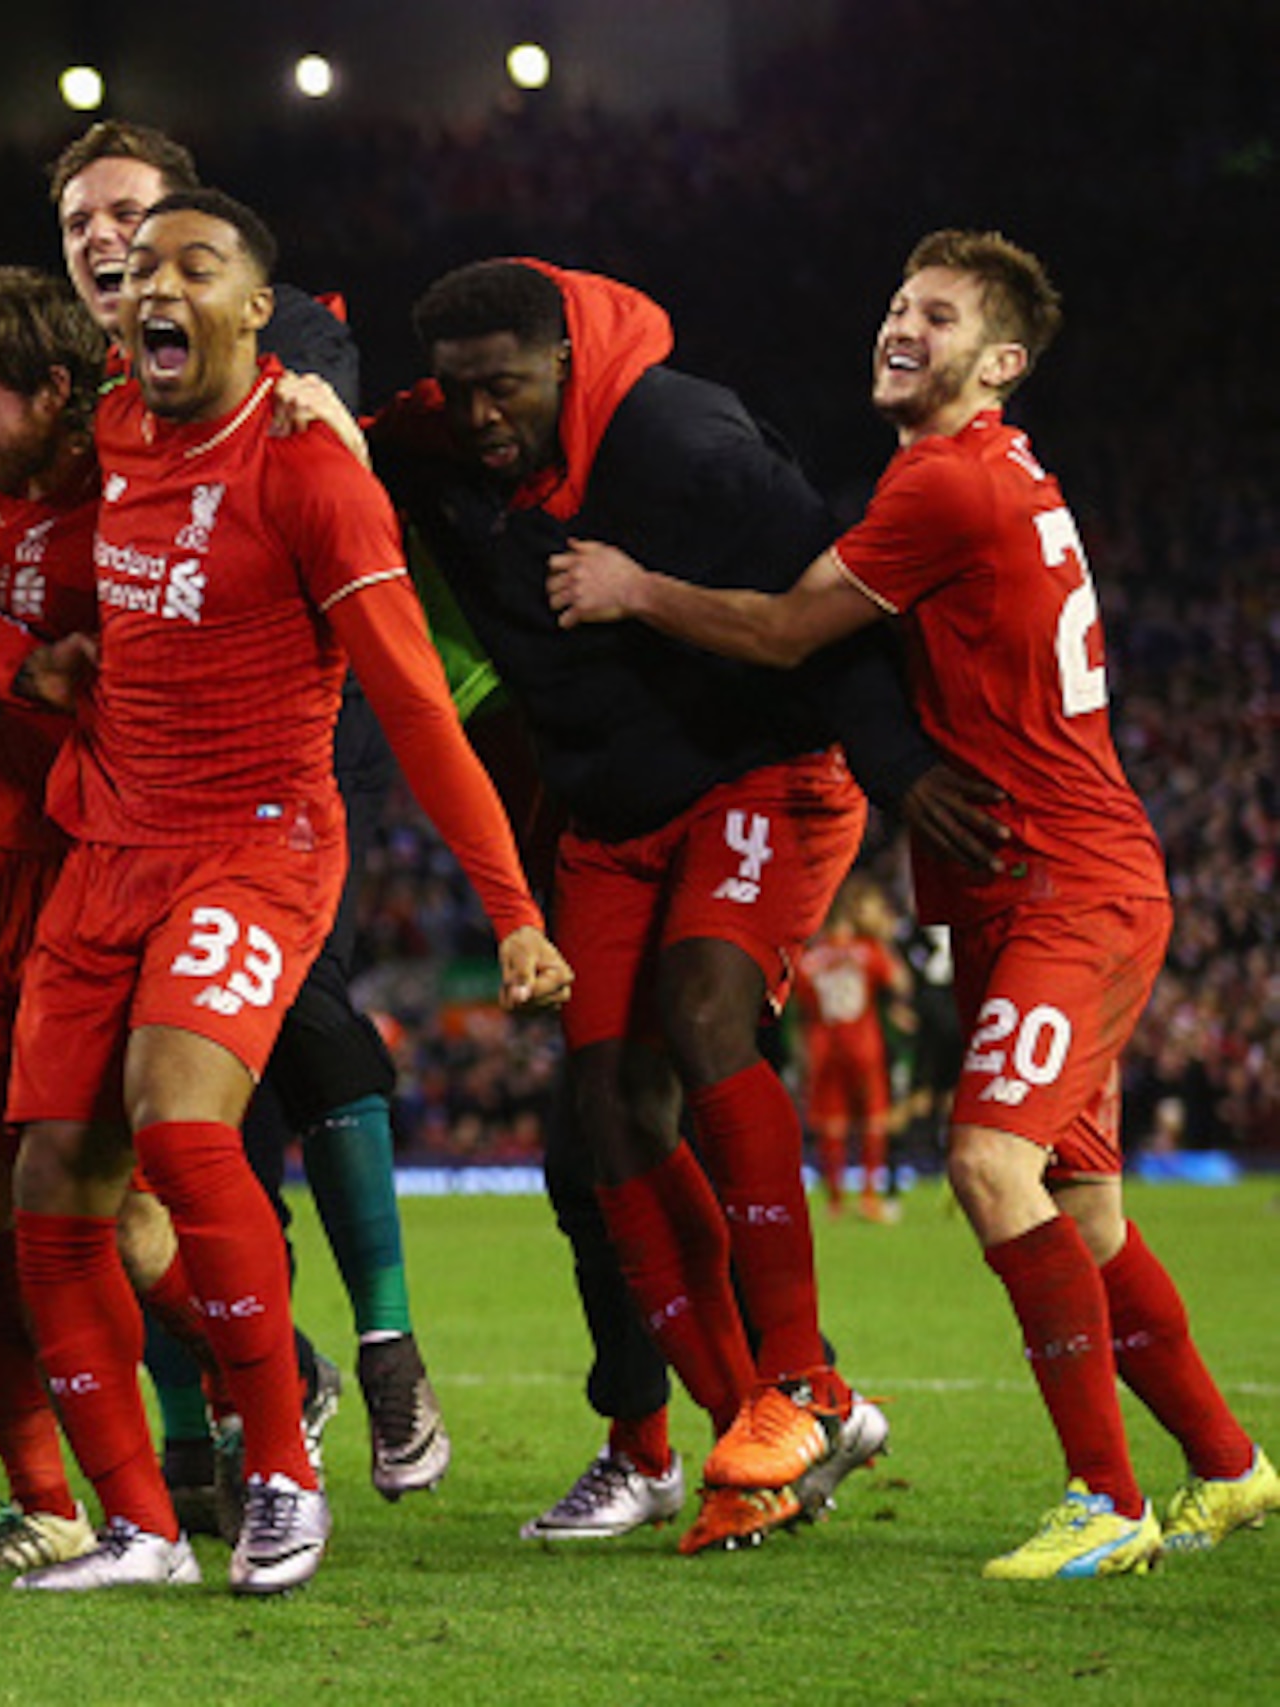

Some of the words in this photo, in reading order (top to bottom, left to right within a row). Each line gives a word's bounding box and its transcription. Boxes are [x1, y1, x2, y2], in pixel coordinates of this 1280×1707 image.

[724, 808, 774, 882] 4
[170, 905, 282, 1008] 33
[963, 997, 1072, 1086] 20
